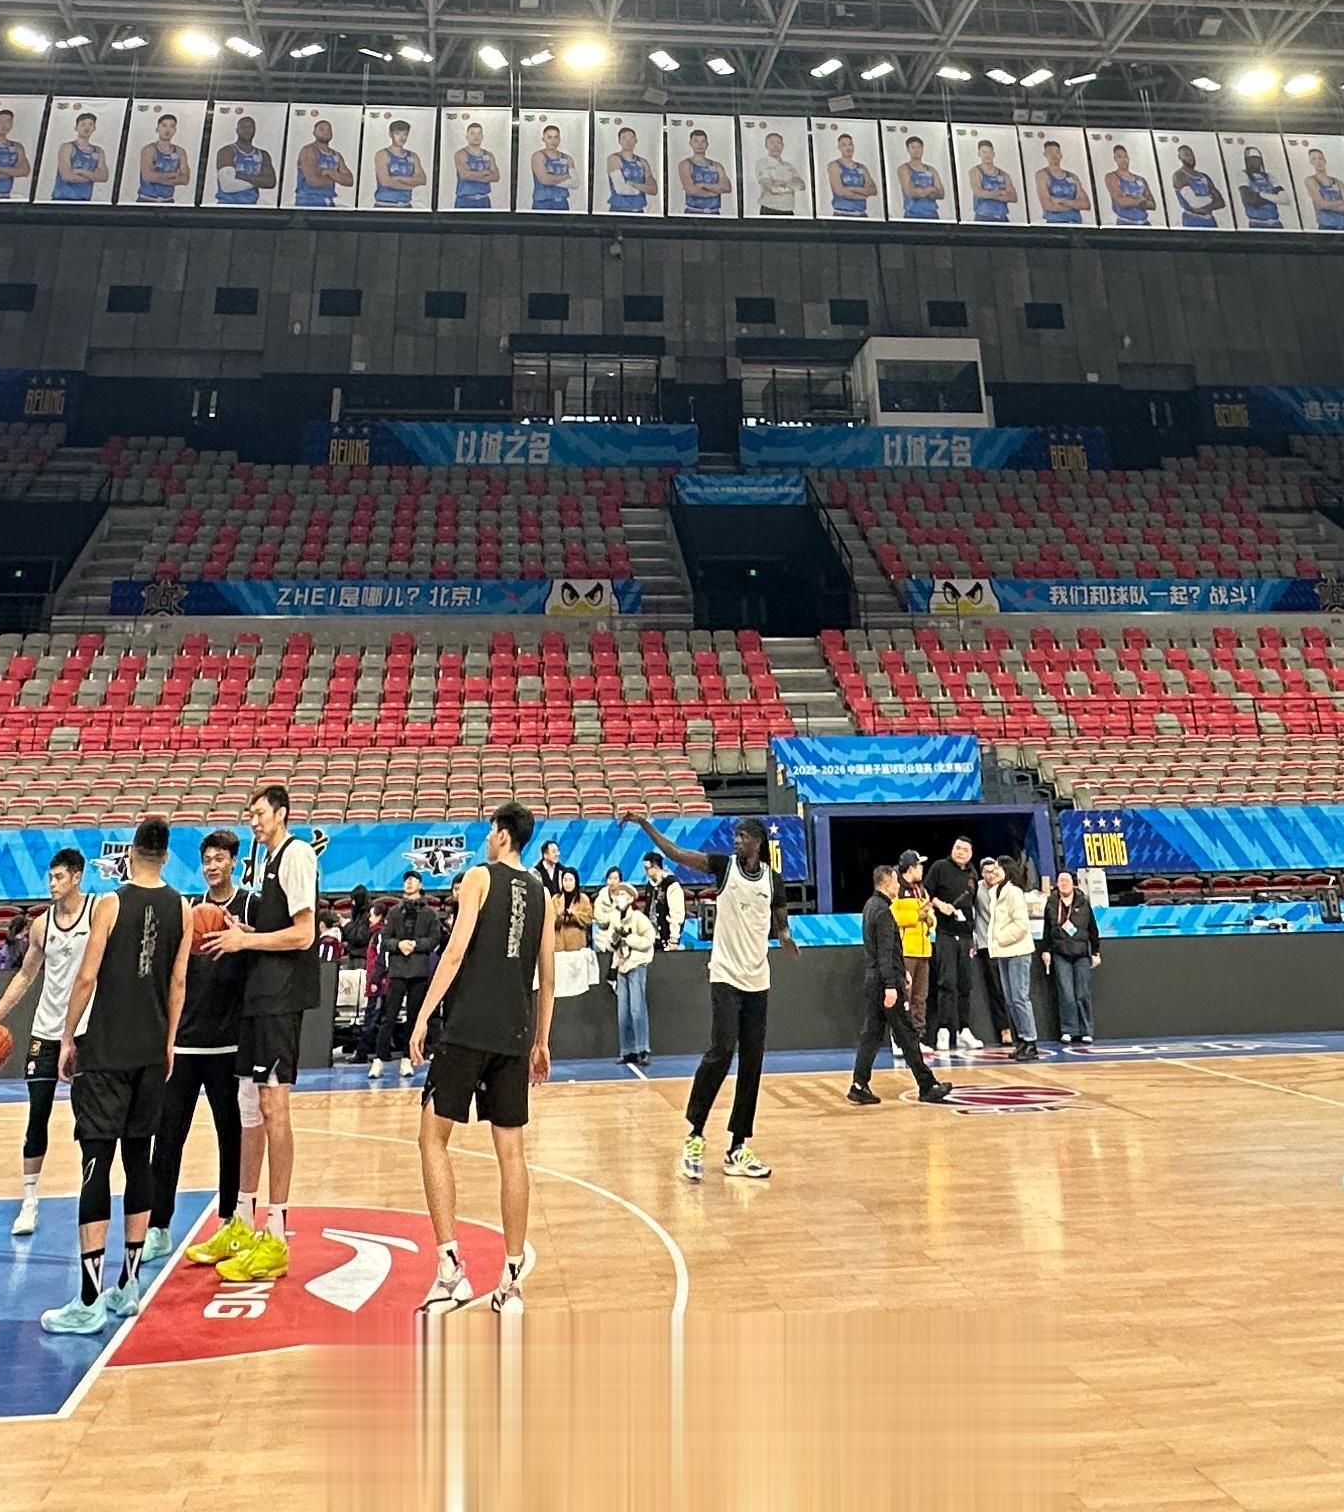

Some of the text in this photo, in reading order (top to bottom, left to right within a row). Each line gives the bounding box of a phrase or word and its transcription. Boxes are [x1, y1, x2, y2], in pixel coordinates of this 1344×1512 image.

[329, 438, 370, 466] BEIJING
[455, 429, 551, 465] 以城之名
[883, 434, 972, 467] 以城之名
[413, 835, 465, 850] DUCKS
[1083, 832, 1128, 867] BEIJING
